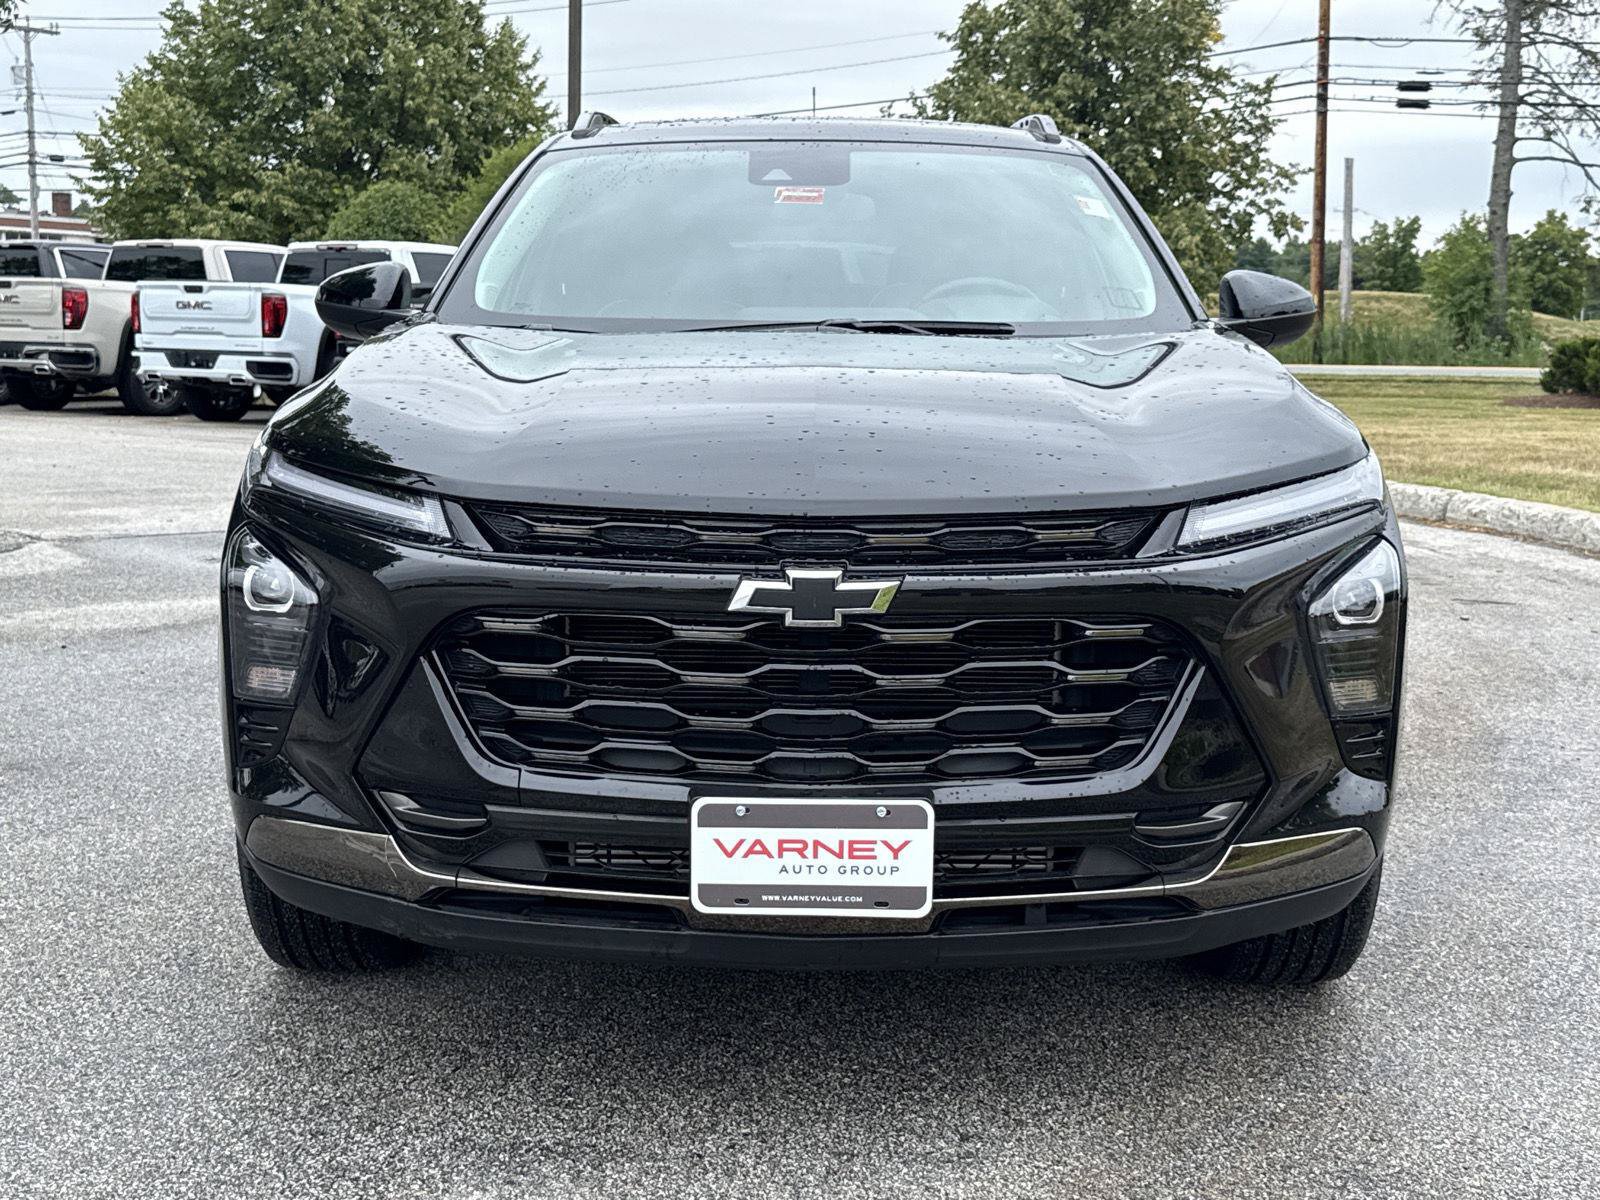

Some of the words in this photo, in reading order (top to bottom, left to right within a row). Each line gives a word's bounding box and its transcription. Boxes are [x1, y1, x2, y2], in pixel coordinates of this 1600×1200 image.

[176, 301, 213, 311] GMC
[713, 838, 912, 860] VARNEY
[778, 865, 828, 875] AUTO
[838, 865, 900, 876] GROUP
[761, 895, 863, 903] WWW.VARNEYVALUE.COM
